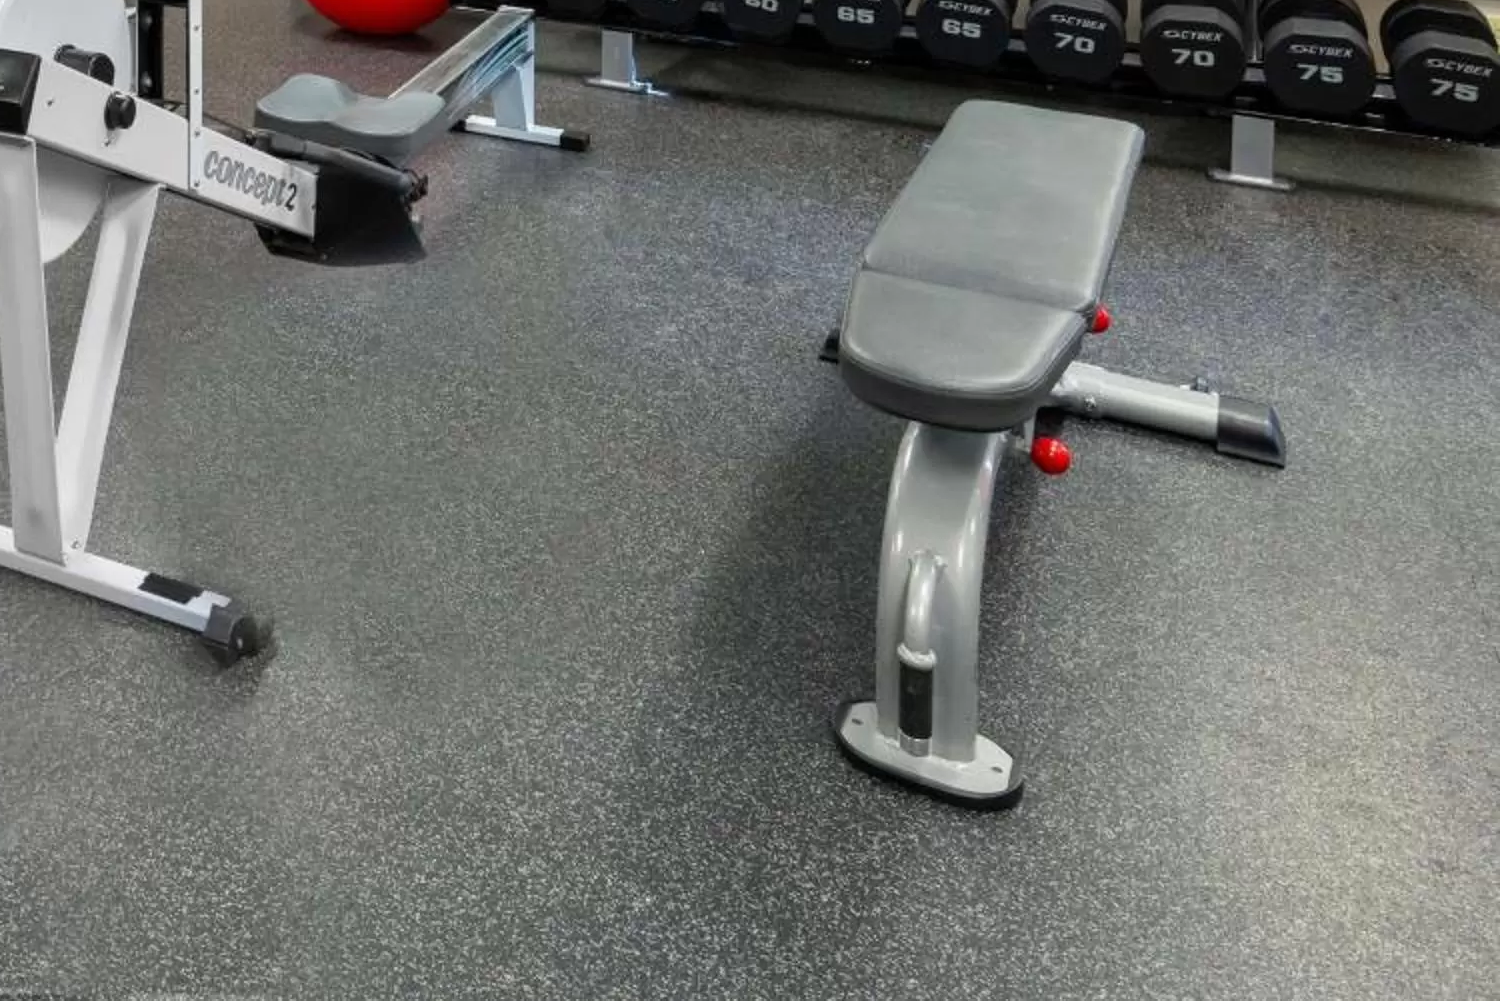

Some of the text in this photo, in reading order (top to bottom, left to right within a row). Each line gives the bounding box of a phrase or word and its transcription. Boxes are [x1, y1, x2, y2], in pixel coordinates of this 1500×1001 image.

[838, 7, 874, 23] 65
[942, 19, 980, 38] 65
[1055, 33, 1094, 53] 70
[1307, 47, 1353, 58] CYBEX
[1172, 49, 1214, 66] 70
[1298, 64, 1343, 83] 75
[1445, 60, 1492, 77] CYBEX
[1431, 79, 1478, 101] 75
[204, 151, 297, 211] concept2
